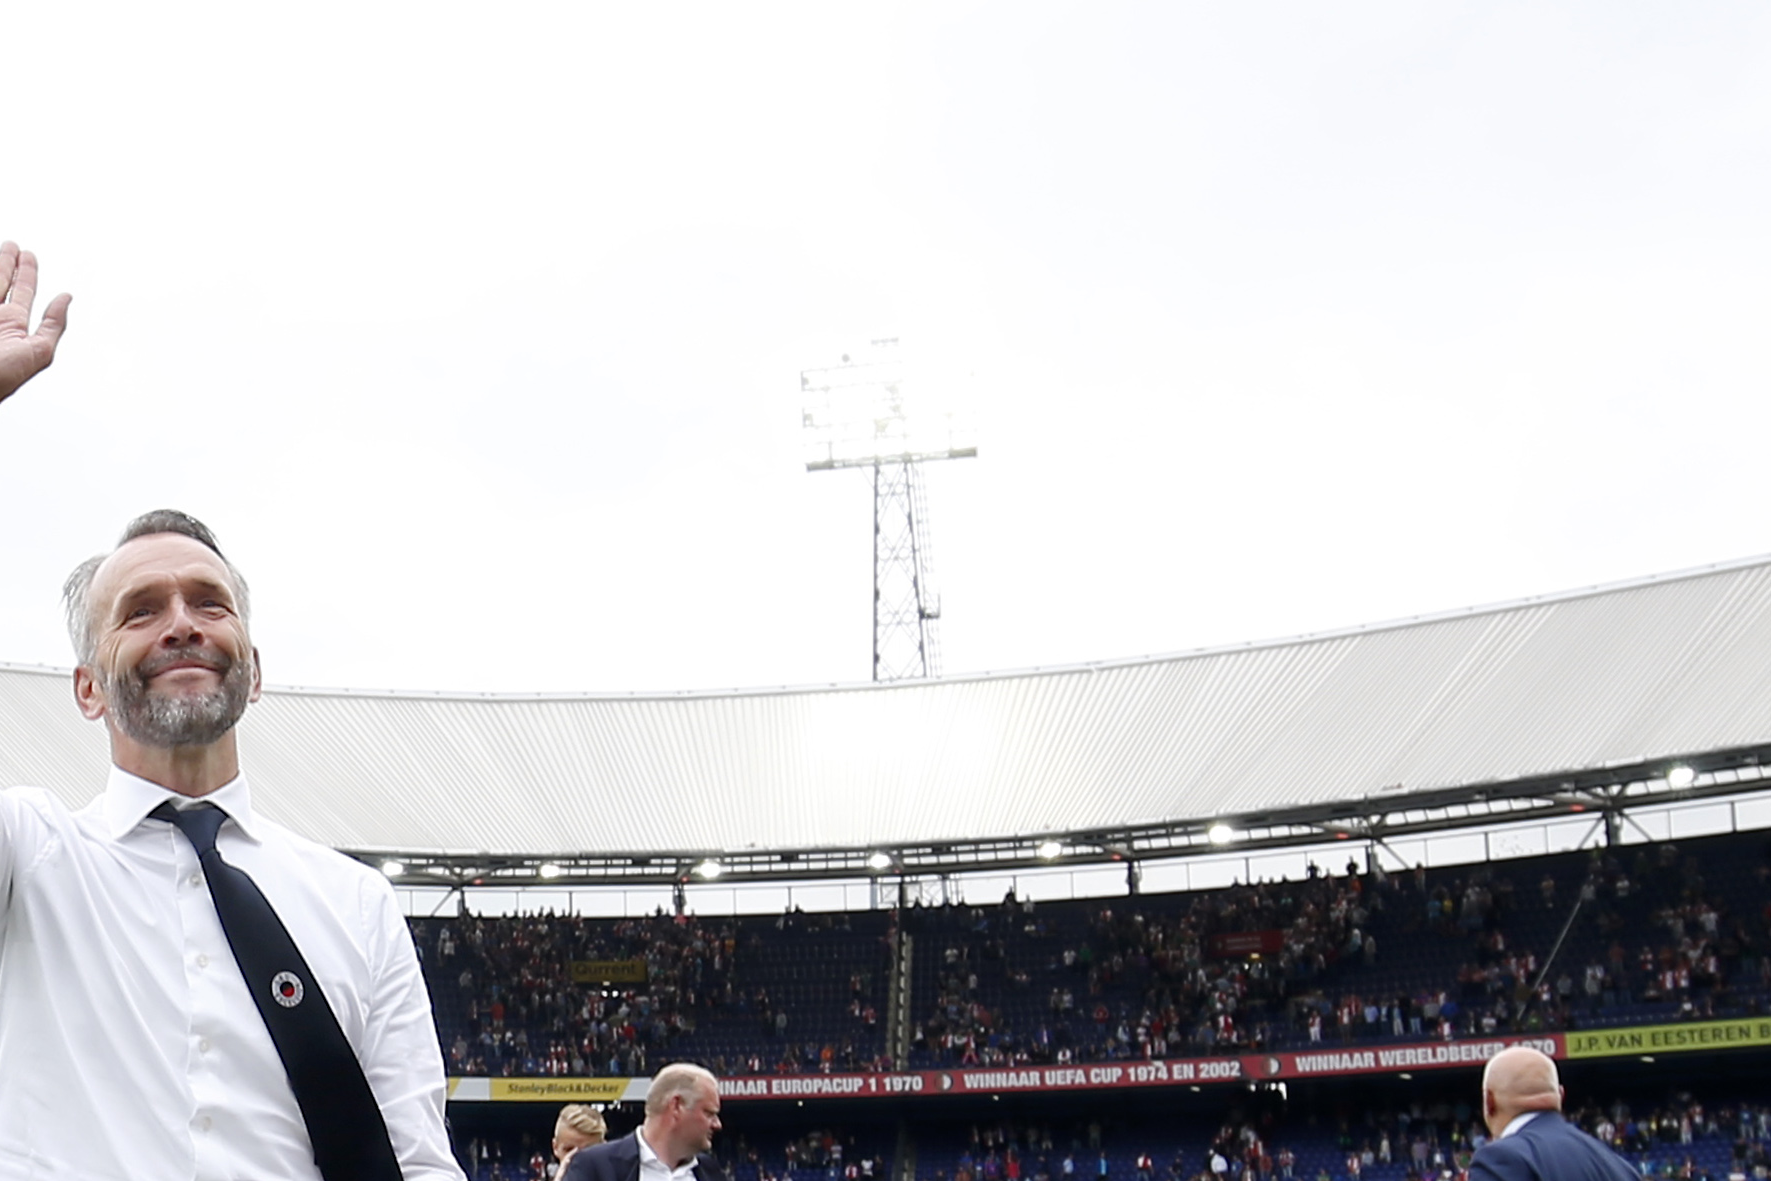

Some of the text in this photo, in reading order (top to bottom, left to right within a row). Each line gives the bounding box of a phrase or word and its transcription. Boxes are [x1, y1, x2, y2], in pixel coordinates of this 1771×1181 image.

[575, 962, 636, 975] Qurrent
[1574, 1037, 1601, 1052] J.P.
[1606, 1034, 1643, 1050] VAN
[1651, 1025, 1752, 1047] EESTEREN
[1295, 1051, 1376, 1073] WINNAAR
[772, 1077, 864, 1095] EUROPACUP
[868, 1077, 877, 1092] 1
[883, 1075, 923, 1092] 1970
[963, 1060, 1241, 1089] WINNAAR UEFA CUP 1974 EN 2002
